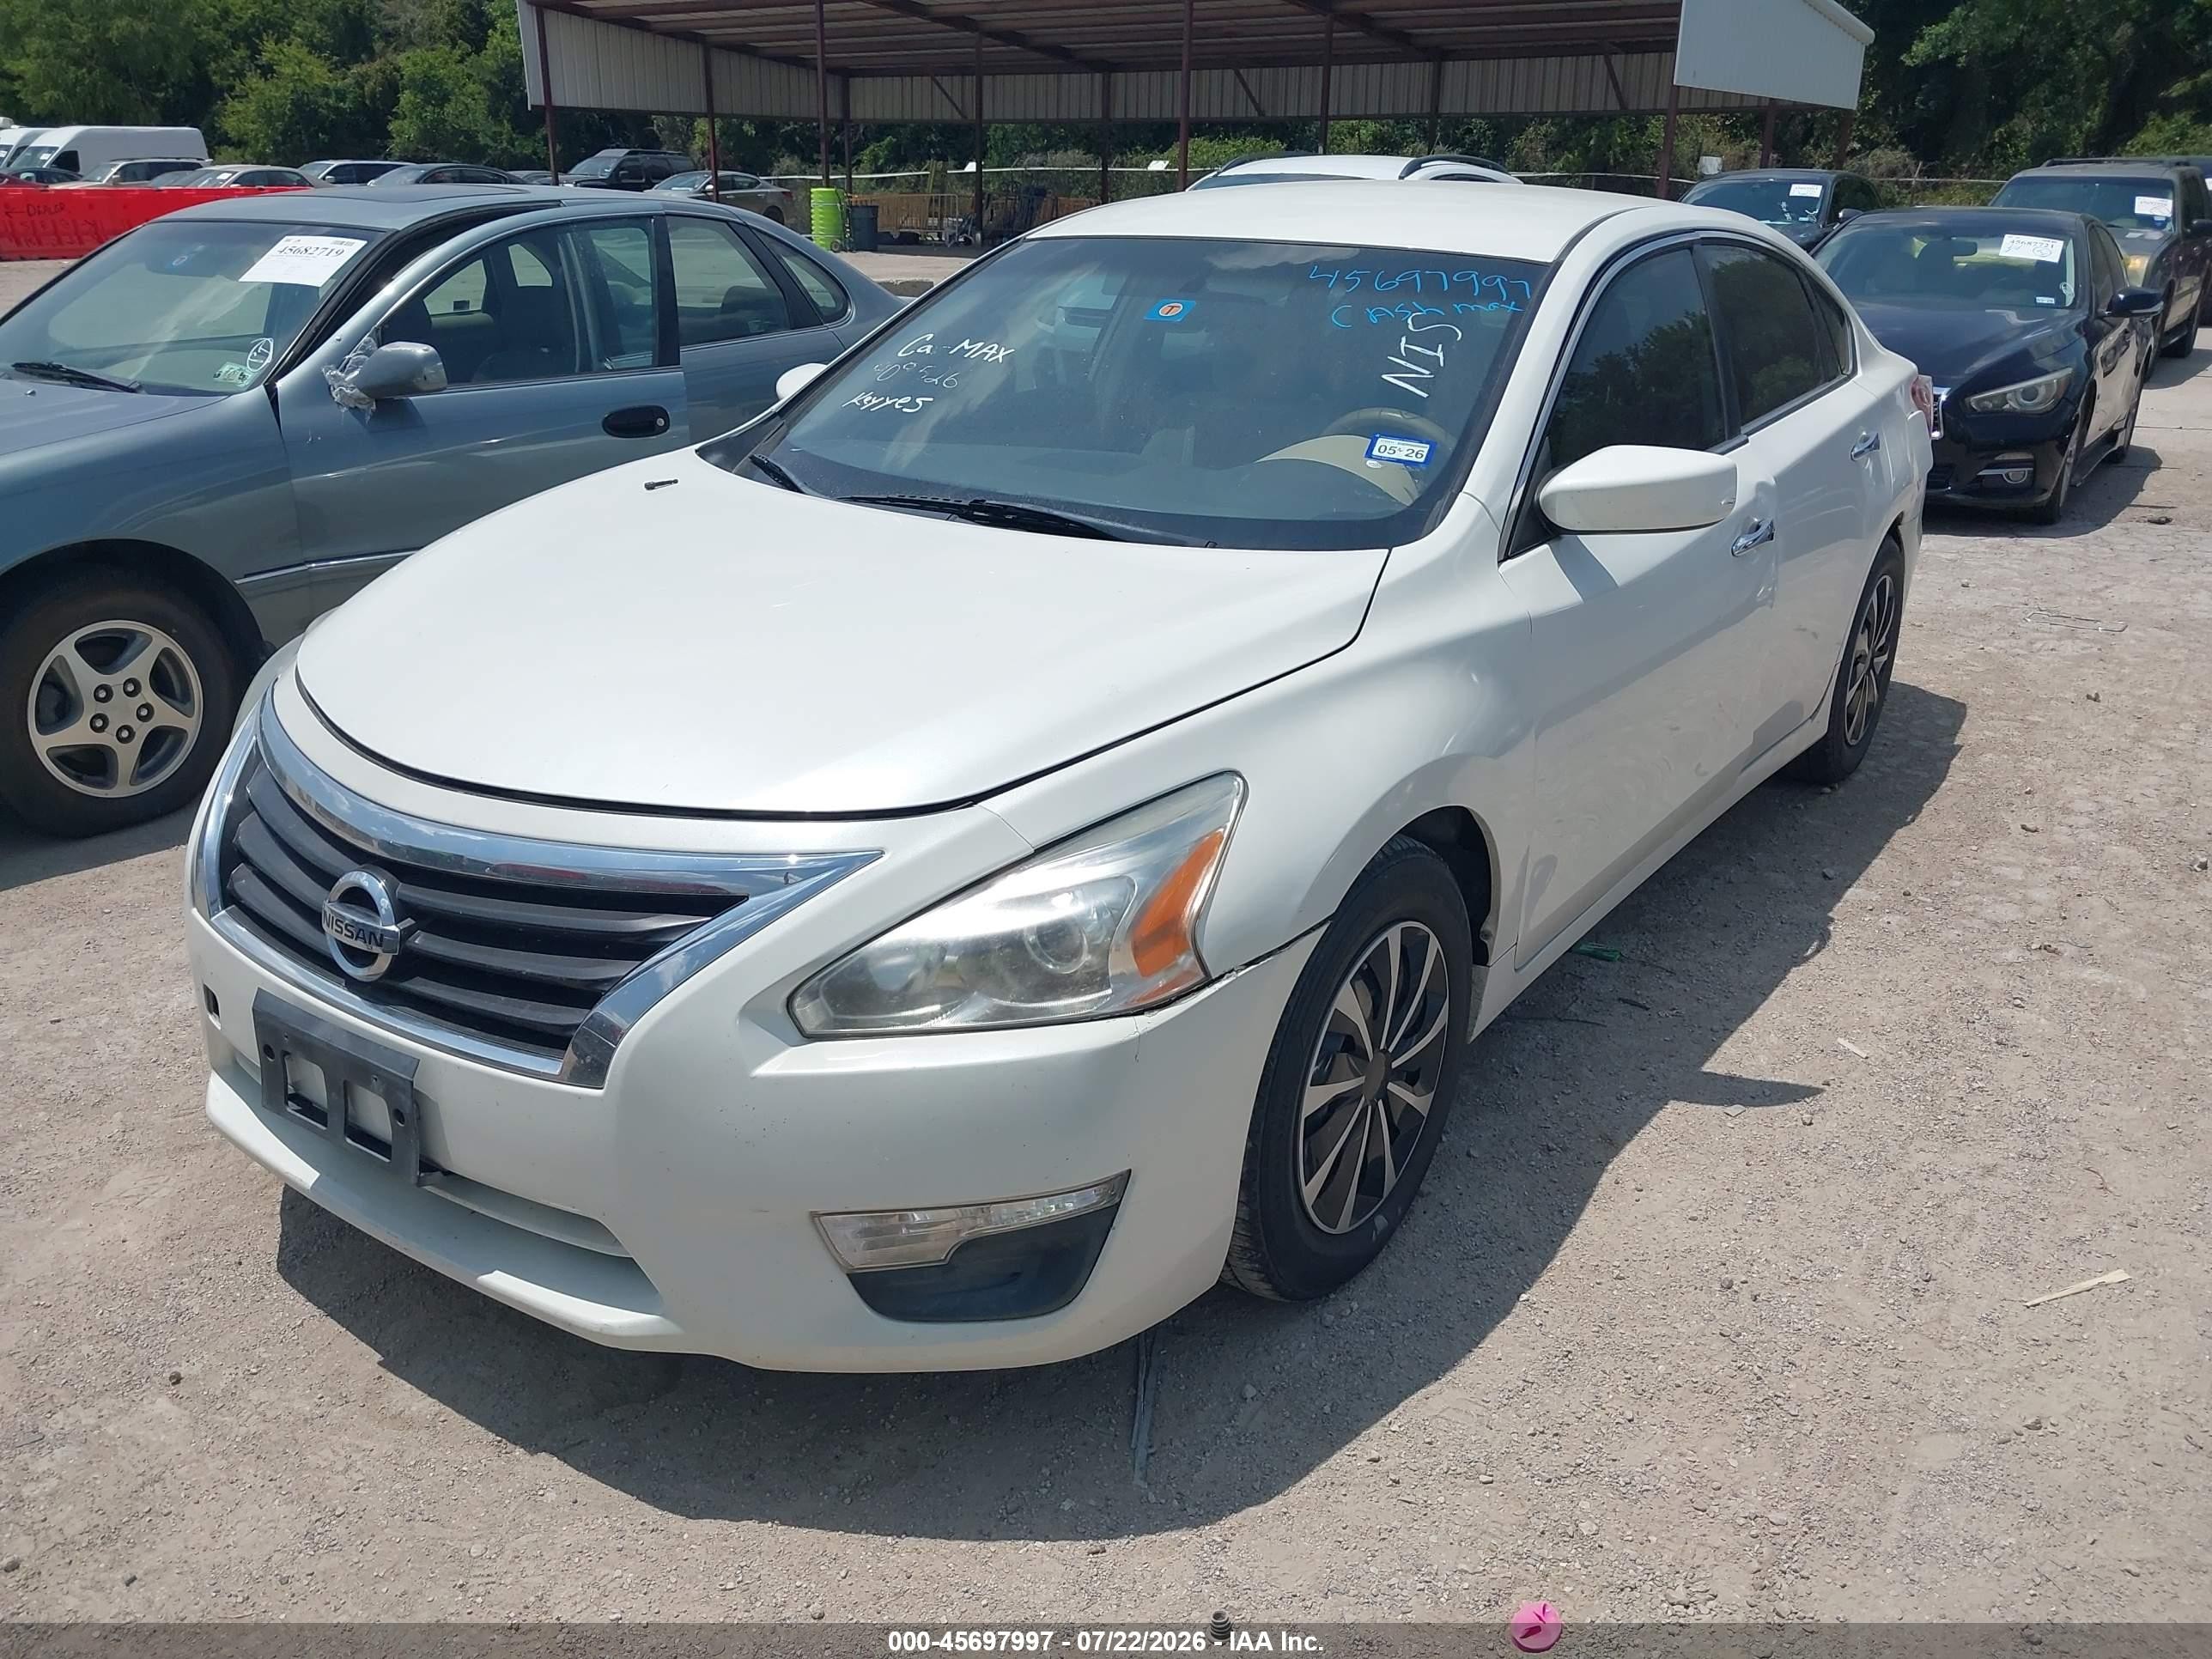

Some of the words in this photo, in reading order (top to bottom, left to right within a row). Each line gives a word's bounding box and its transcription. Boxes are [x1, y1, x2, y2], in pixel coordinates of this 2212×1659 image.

[277, 246, 345, 257] 45682719
[1309, 265, 1531, 301] 45697997
[1380, 312, 1462, 398] NIS
[323, 910, 384, 947] NISSAN
